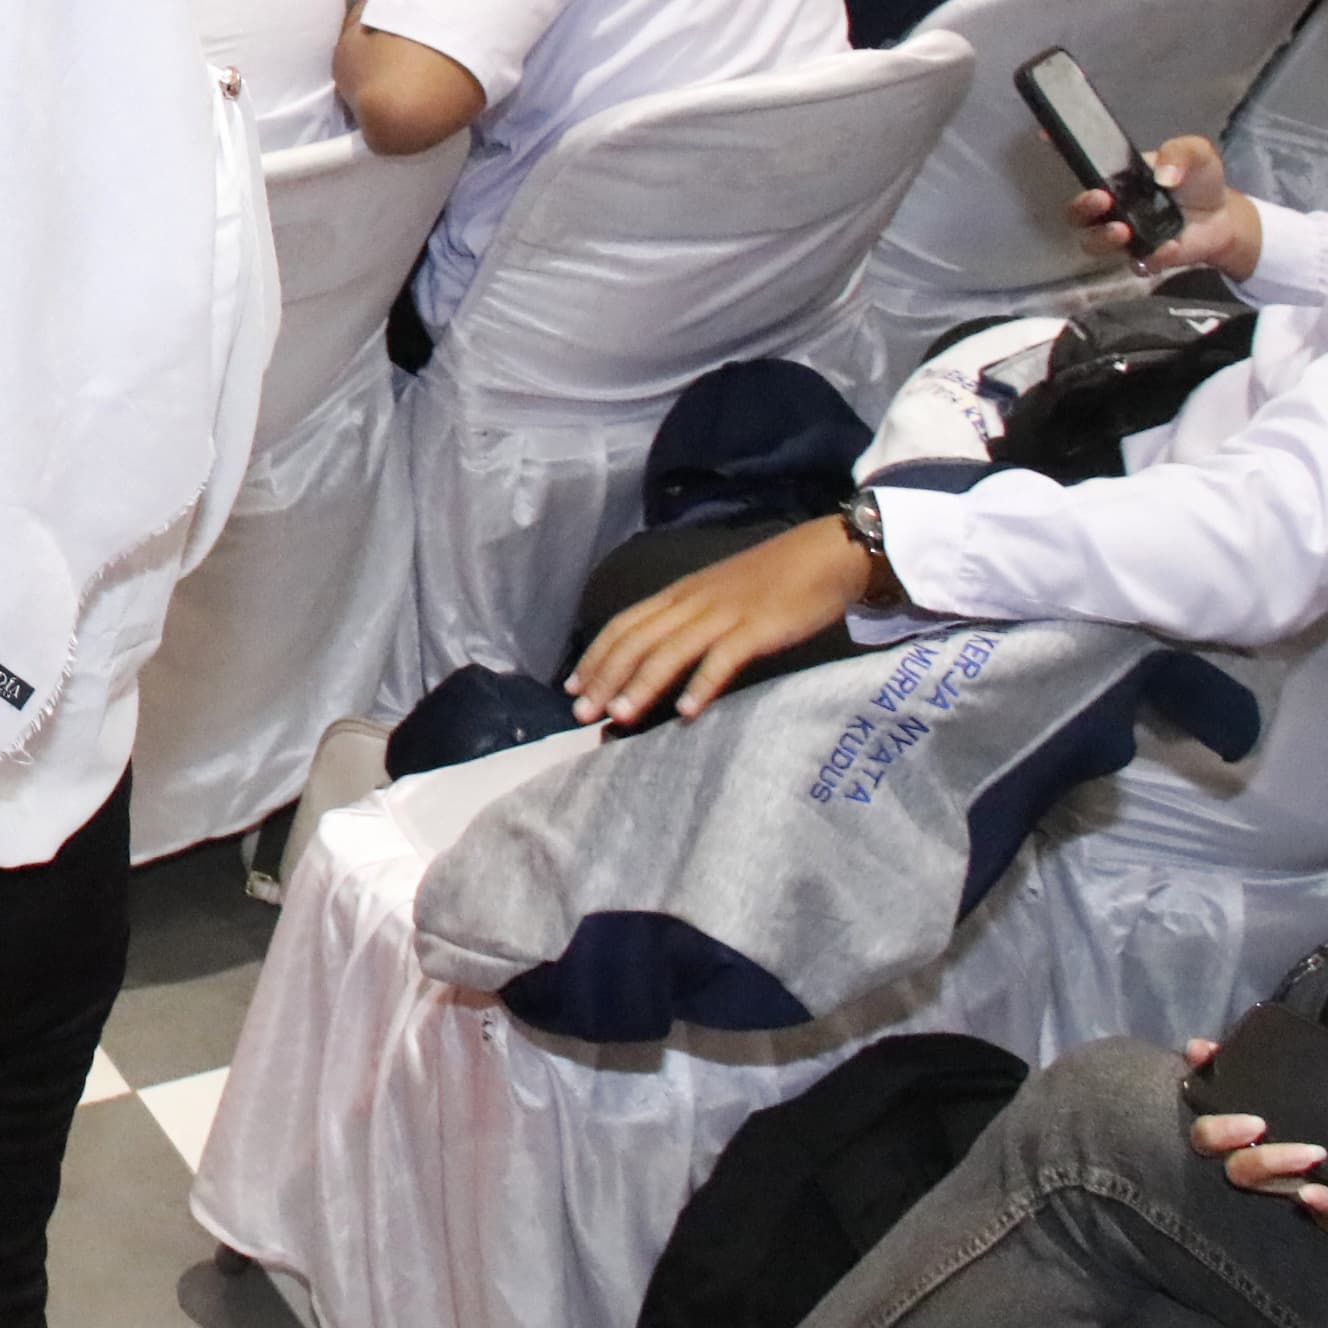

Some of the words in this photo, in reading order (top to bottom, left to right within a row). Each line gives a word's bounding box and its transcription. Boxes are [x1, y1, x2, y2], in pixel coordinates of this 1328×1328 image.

[870, 642, 939, 712] MURIA
[925, 634, 1000, 709] KERJA
[810, 715, 875, 803] KUDUS
[844, 716, 930, 803] NYATA
